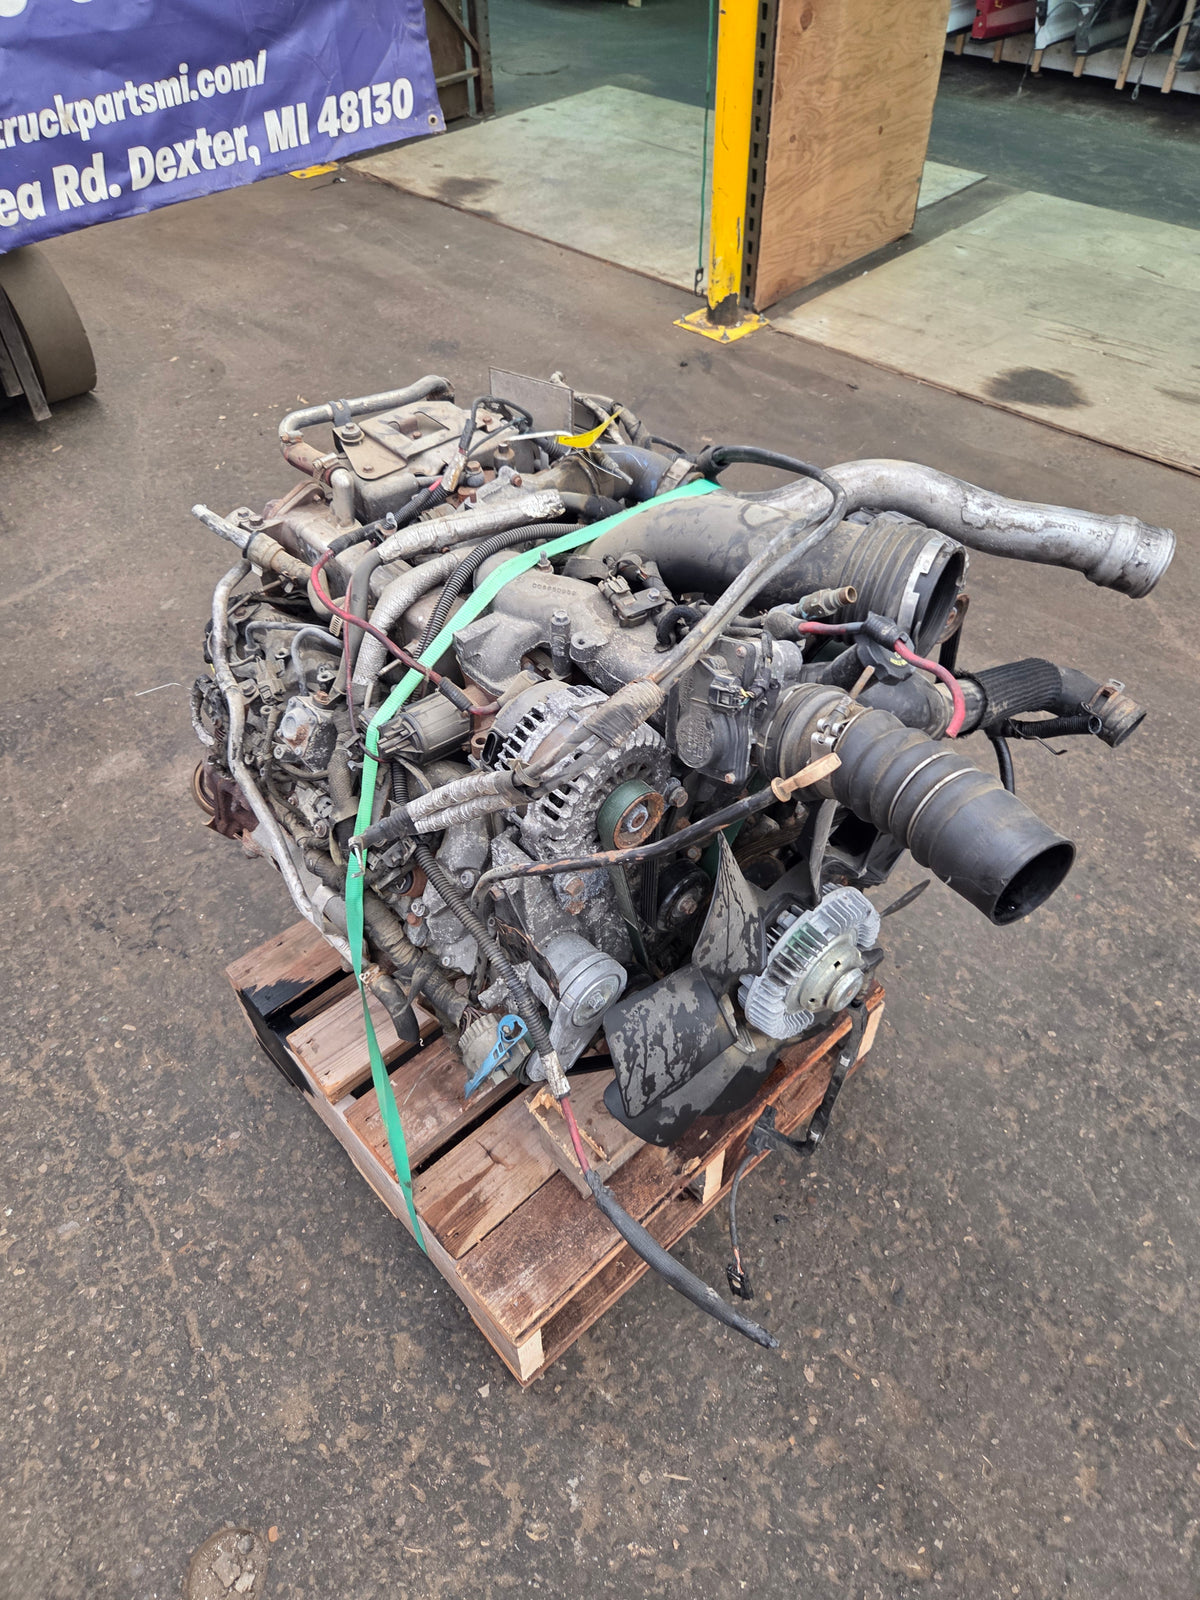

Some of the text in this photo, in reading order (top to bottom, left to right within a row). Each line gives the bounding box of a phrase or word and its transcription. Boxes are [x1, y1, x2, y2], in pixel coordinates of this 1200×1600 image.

[52, 151, 122, 211] Rd.
[128, 124, 262, 192] Dexter,
[264, 102, 310, 153] MI
[317, 77, 414, 138] 48130
